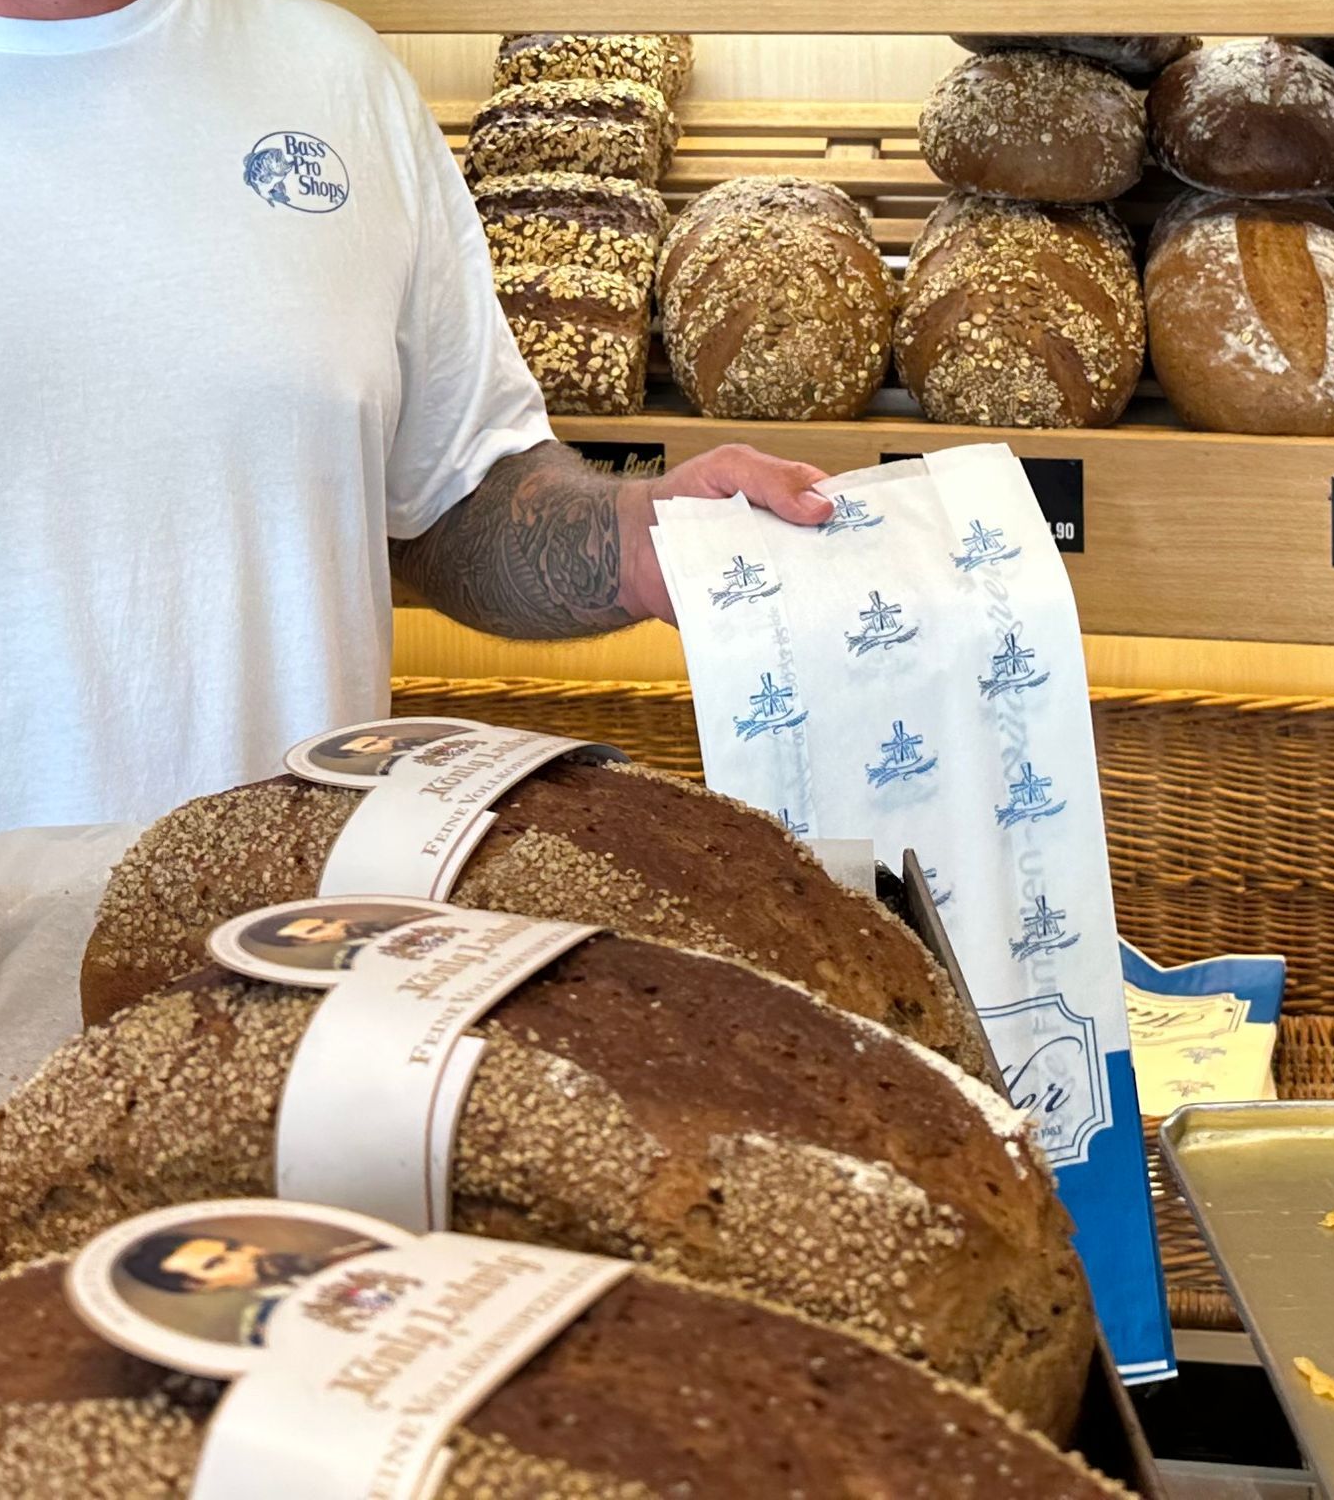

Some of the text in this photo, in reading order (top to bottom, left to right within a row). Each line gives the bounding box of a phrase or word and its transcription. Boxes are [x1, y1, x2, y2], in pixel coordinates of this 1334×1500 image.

[284, 134, 326, 158] Bass
[292, 155, 322, 177] Pro
[298, 174, 346, 203] Shops
